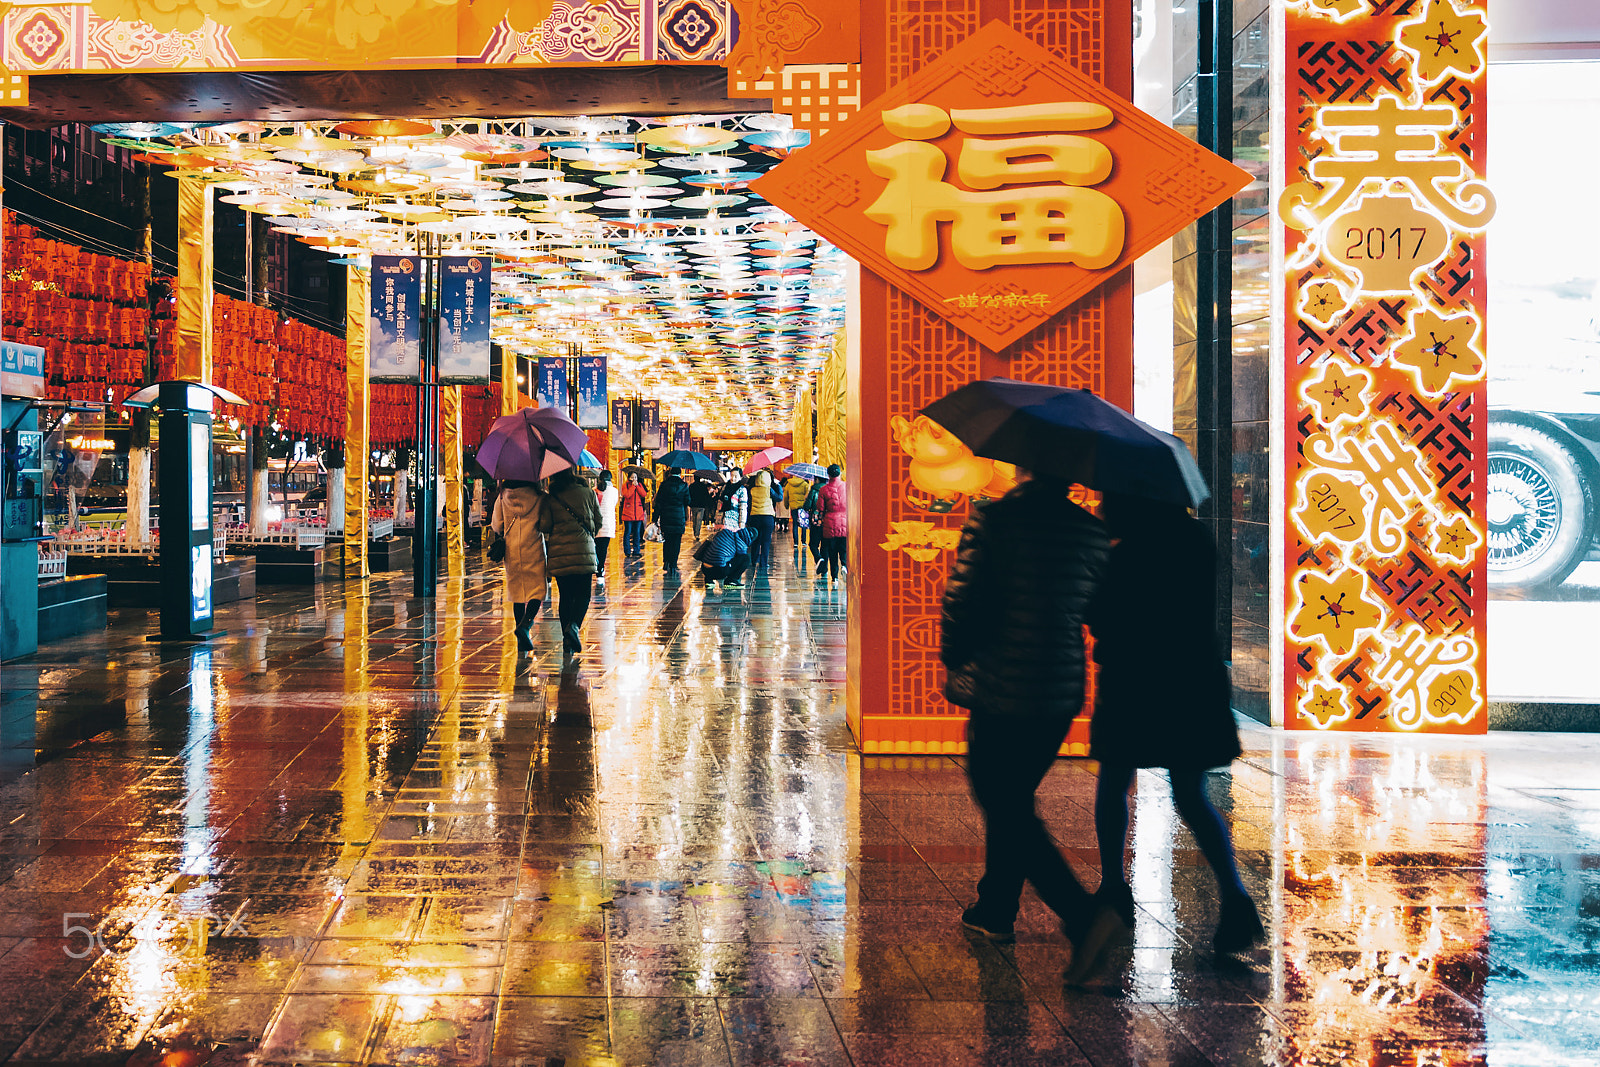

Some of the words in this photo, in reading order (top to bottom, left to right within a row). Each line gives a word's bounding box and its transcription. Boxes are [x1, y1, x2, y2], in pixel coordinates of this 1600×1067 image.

[864, 101, 1126, 271] 福
[1346, 228, 1427, 260] 2017
[385, 277, 395, 322] 你我同参与
[464, 279, 475, 324] 做城市主人
[1310, 482, 1356, 531] 2017
[1432, 674, 1469, 715] 2017
